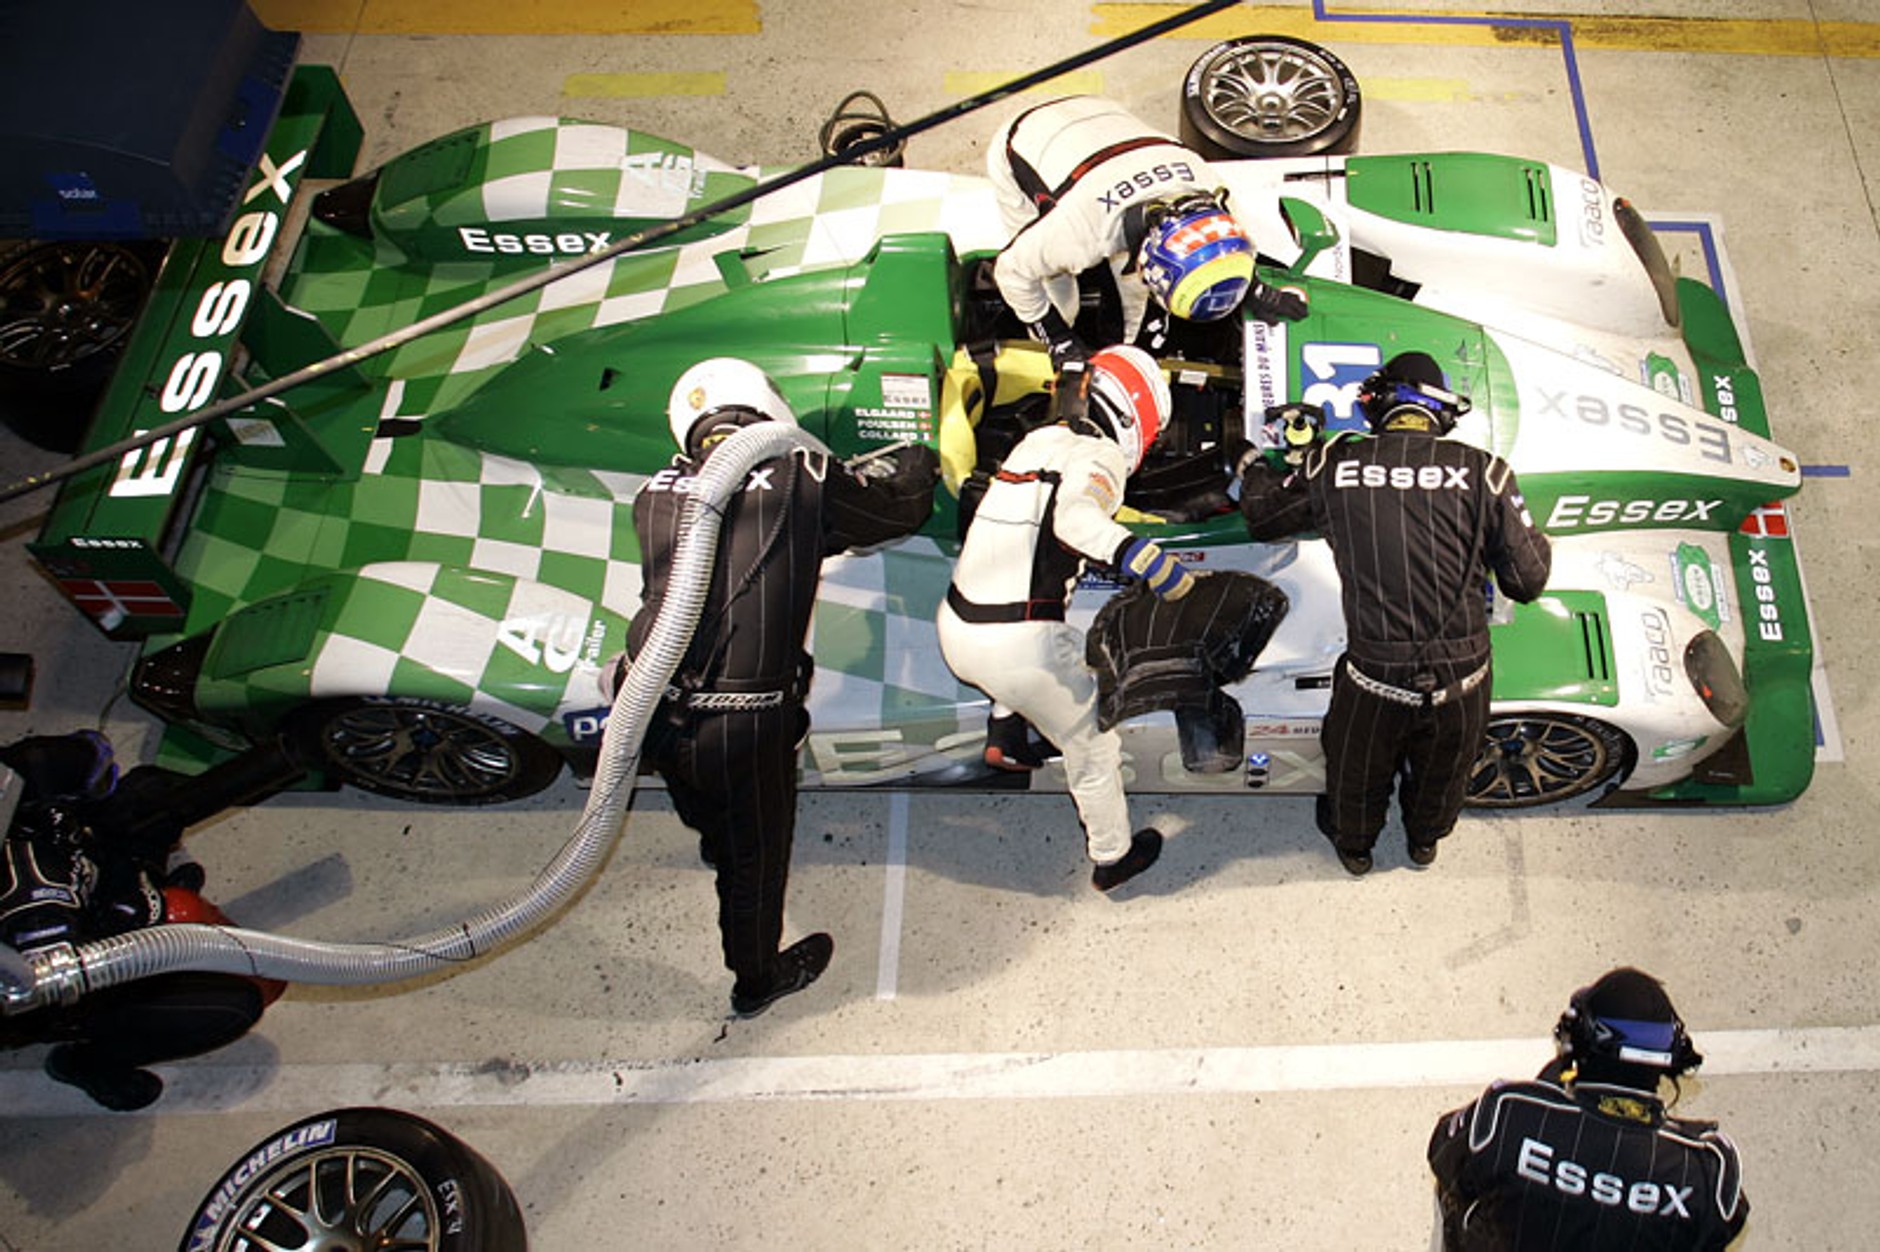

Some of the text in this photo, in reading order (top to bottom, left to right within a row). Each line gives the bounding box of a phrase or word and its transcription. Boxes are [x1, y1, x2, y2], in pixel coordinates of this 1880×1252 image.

[1096, 162, 1195, 214] Essex
[457, 226, 612, 253] Essex
[108, 149, 308, 497] Essex
[1534, 385, 1733, 464] Essex
[1713, 375, 1738, 423] sex
[646, 468, 775, 493] Esx
[1334, 460, 1470, 490] Essex
[1546, 496, 1725, 529] Essex
[1748, 549, 1784, 642] Essex
[206, 1121, 335, 1212] MICHELIN
[1516, 1136, 1694, 1219] Essex
